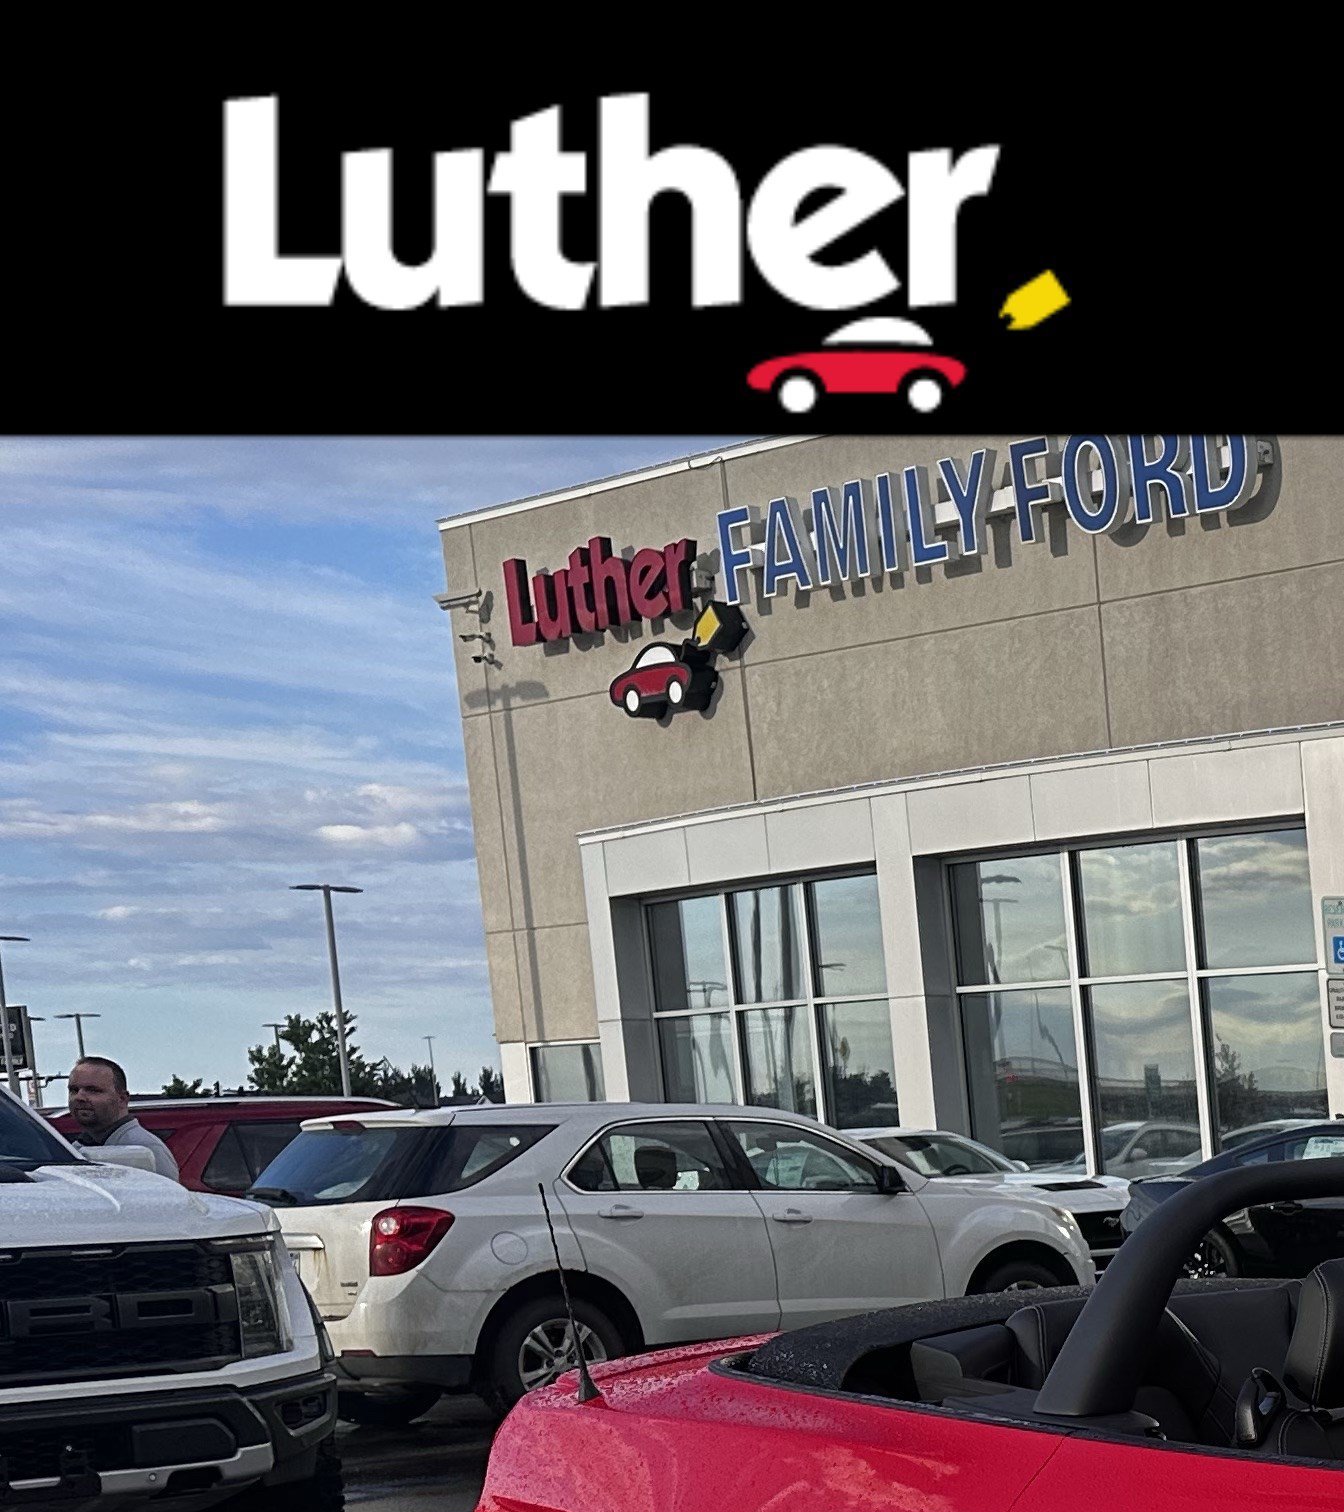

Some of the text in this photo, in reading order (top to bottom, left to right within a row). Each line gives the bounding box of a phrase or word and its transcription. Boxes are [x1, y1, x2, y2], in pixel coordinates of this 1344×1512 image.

[716, 433, 1252, 606] FAMILY FORD
[502, 535, 698, 648] Luther
